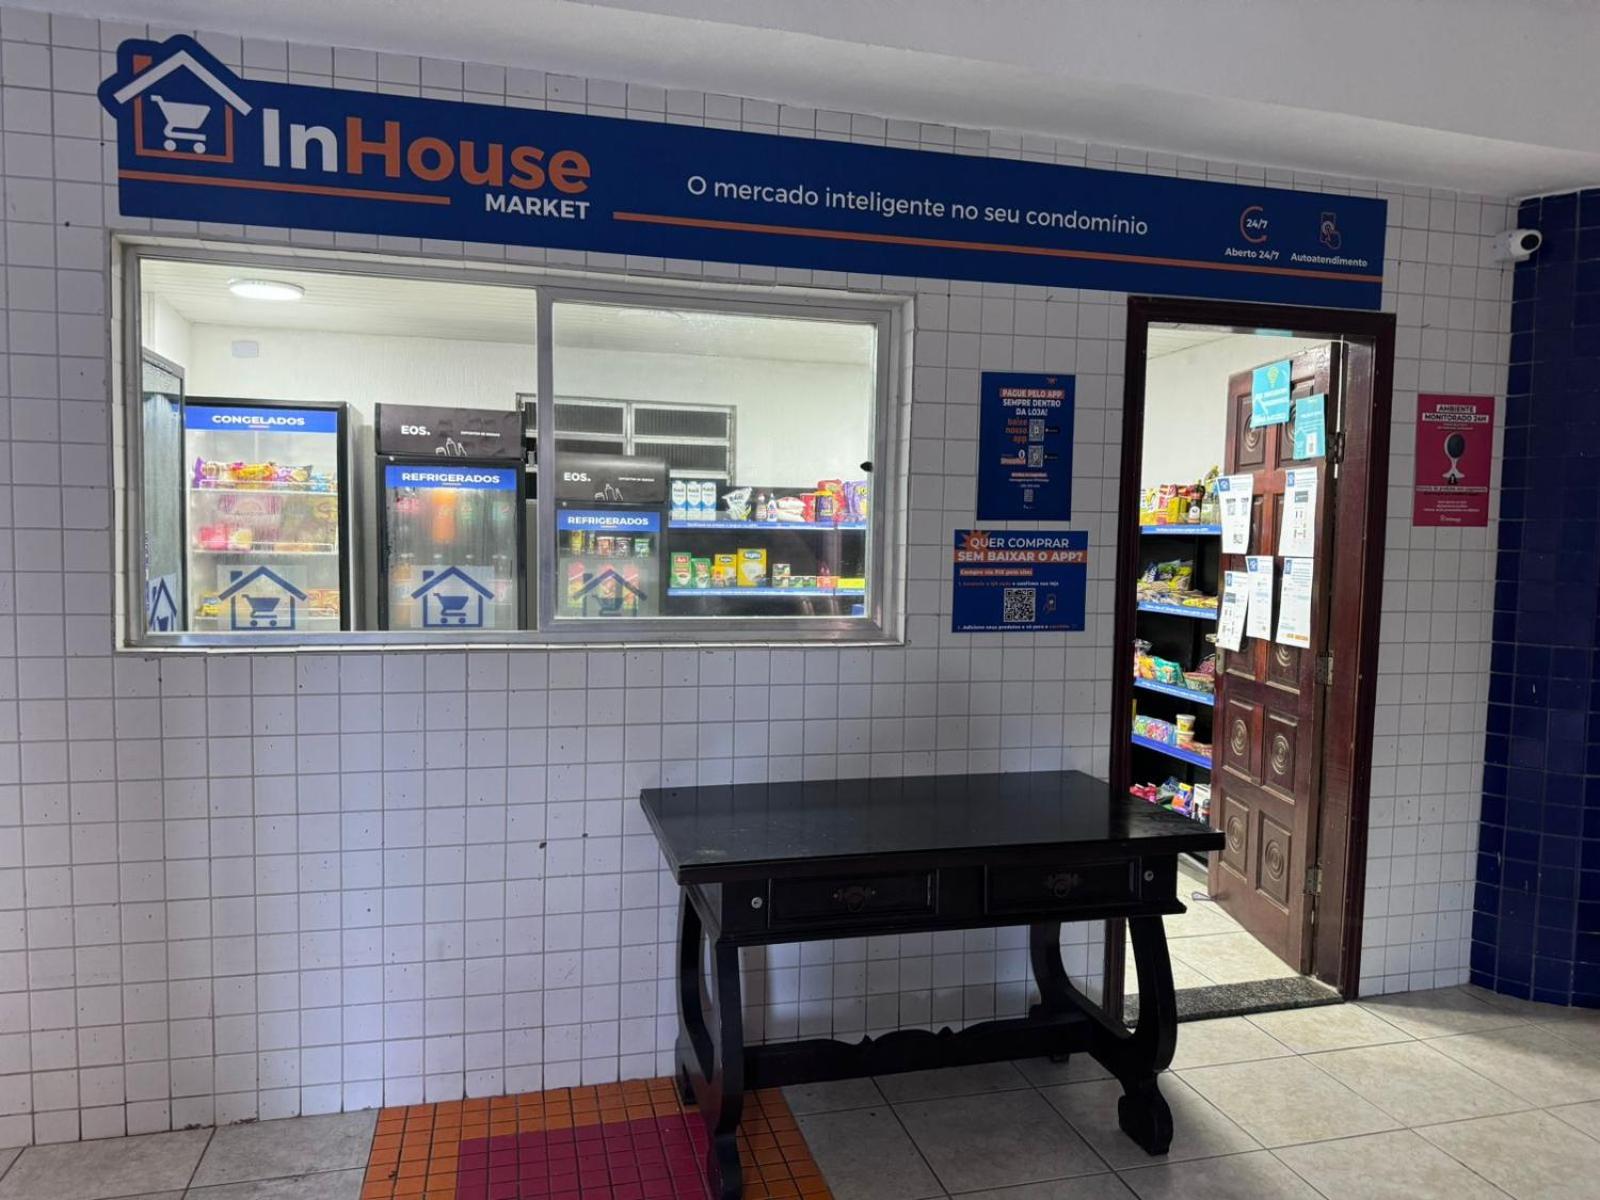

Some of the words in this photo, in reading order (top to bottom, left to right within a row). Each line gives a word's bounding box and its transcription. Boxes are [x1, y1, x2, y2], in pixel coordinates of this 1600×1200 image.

[262, 108, 592, 194] InHouse
[485, 192, 591, 221] MARKET
[687, 175, 707, 196] O
[714, 180, 819, 207] mercado
[826, 185, 946, 218] inteligente
[952, 202, 979, 219] no
[984, 204, 1020, 224] seu
[1026, 206, 1148, 236] condomínio
[1246, 217, 1268, 230] 24/7
[1225, 246, 1257, 259] Aberto
[1259, 248, 1279, 261] 24/7
[1290, 252, 1368, 269] Autoatendimento
[1002, 389, 1027, 398] PAGUE
[1028, 389, 1046, 398] PELO
[1048, 390, 1063, 399] APP
[1002, 399, 1031, 407] SEMPRE
[1032, 399, 1061, 408] DENTRO
[1439, 405, 1474, 413] AMBIENTE
[1015, 408, 1026, 416] DA
[1028, 408, 1048, 417] LOJA!
[1425, 413, 1473, 422] MONITORADO
[211, 415, 305, 427] CONGELADOS
[400, 424, 431, 437] EOS.
[402, 472, 501, 485] REFRIGERADOS
[563, 471, 591, 483] EOS.
[567, 515, 649, 527] REFRIGERADOS
[970, 537, 1004, 550] QUER
[1008, 537, 1070, 549] COMPRAR
[958, 551, 984, 562] SEM
[987, 551, 1035, 562] BAIXAR
[1038, 551, 1048, 562] O
[1051, 552, 1083, 562] APP?
